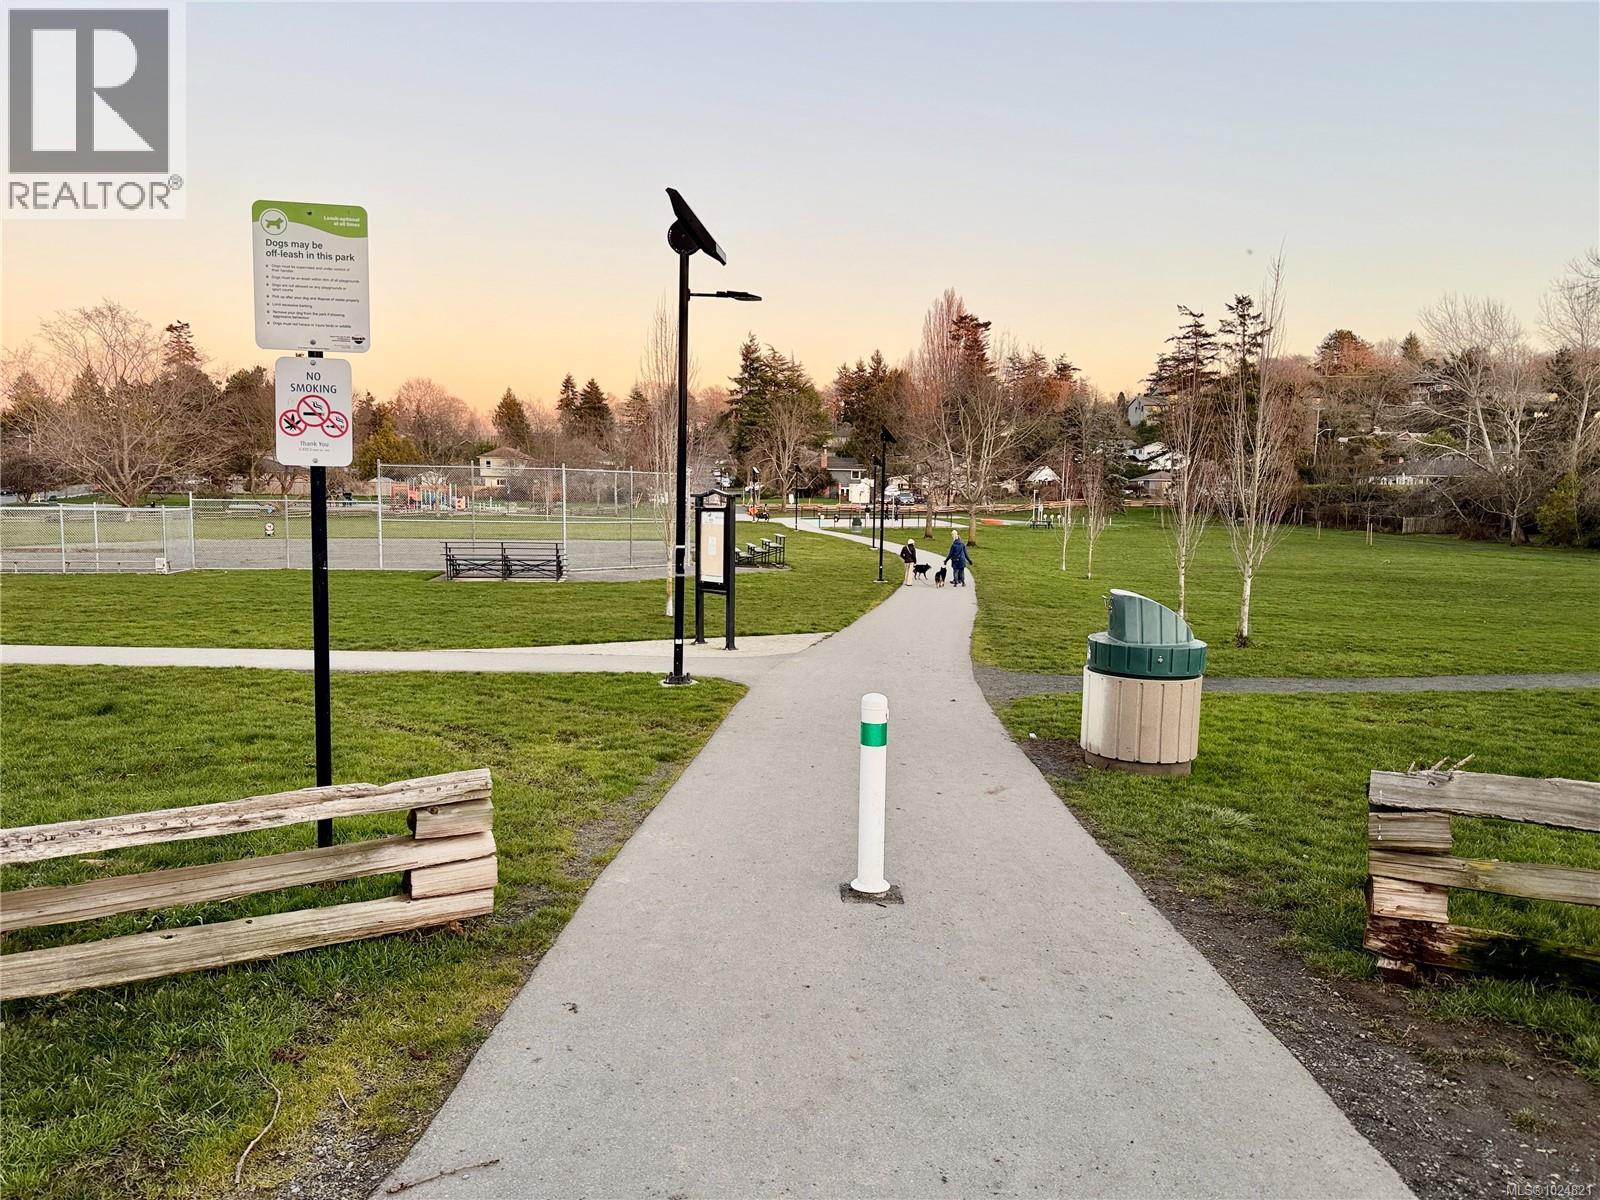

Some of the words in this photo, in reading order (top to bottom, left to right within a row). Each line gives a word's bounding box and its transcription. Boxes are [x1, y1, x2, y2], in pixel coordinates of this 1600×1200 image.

[266, 238, 288, 249] Dogs
[291, 240, 309, 250] may
[312, 241, 323, 249] be
[266, 249, 304, 259] off-leash
[307, 251, 314, 259] in
[317, 252, 333, 260] this
[335, 253, 355, 262] park
[306, 372, 321, 380] NO
[290, 383, 336, 393] SMOKING
